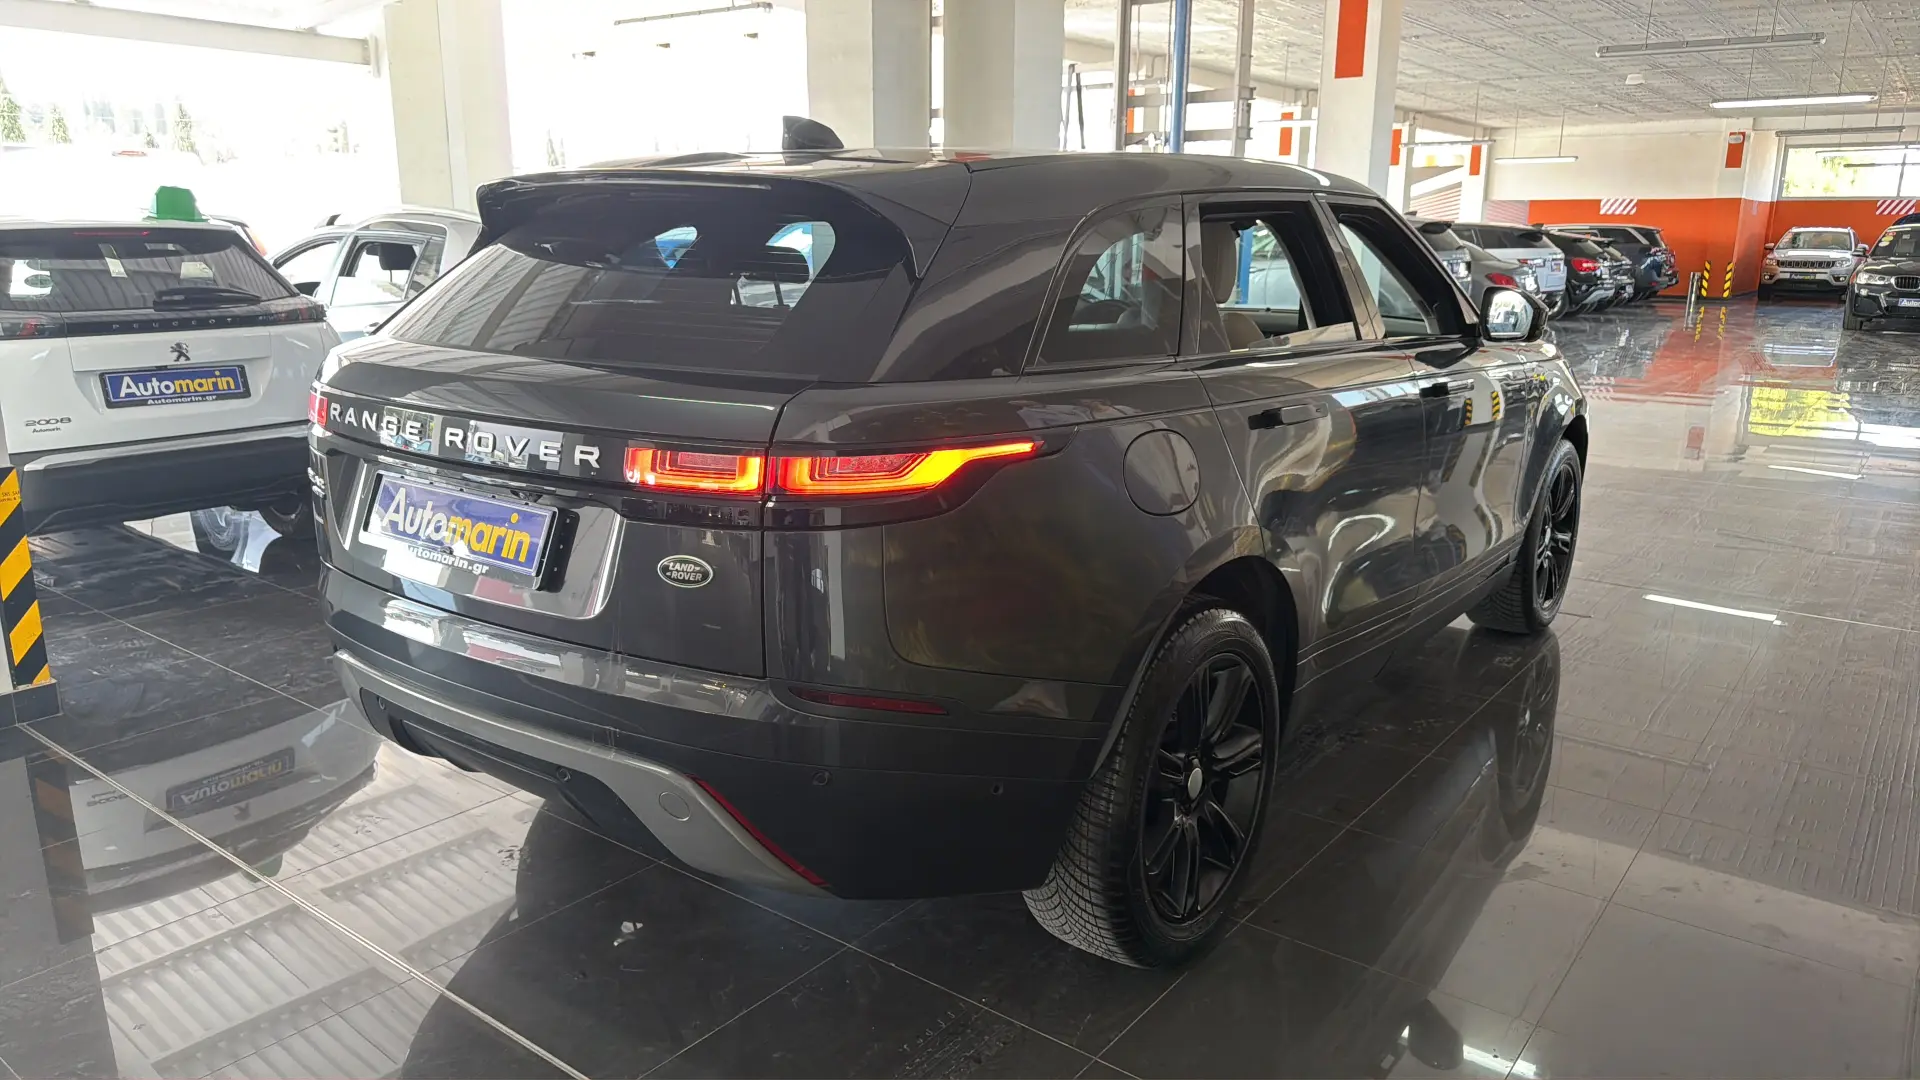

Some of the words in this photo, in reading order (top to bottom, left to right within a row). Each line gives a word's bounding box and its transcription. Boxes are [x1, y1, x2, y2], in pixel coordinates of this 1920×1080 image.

[119, 371, 235, 398] Automarin
[147, 394, 217, 405] Automarin.gr
[25, 416, 72, 427] 2008
[330, 402, 423, 441] RANGE
[445, 427, 601, 469] ROVER
[381, 487, 532, 563] Automarin
[403, 545, 490, 576] utomarin.gr
[668, 561, 695, 572] LAND
[670, 570, 703, 581] ROVER
